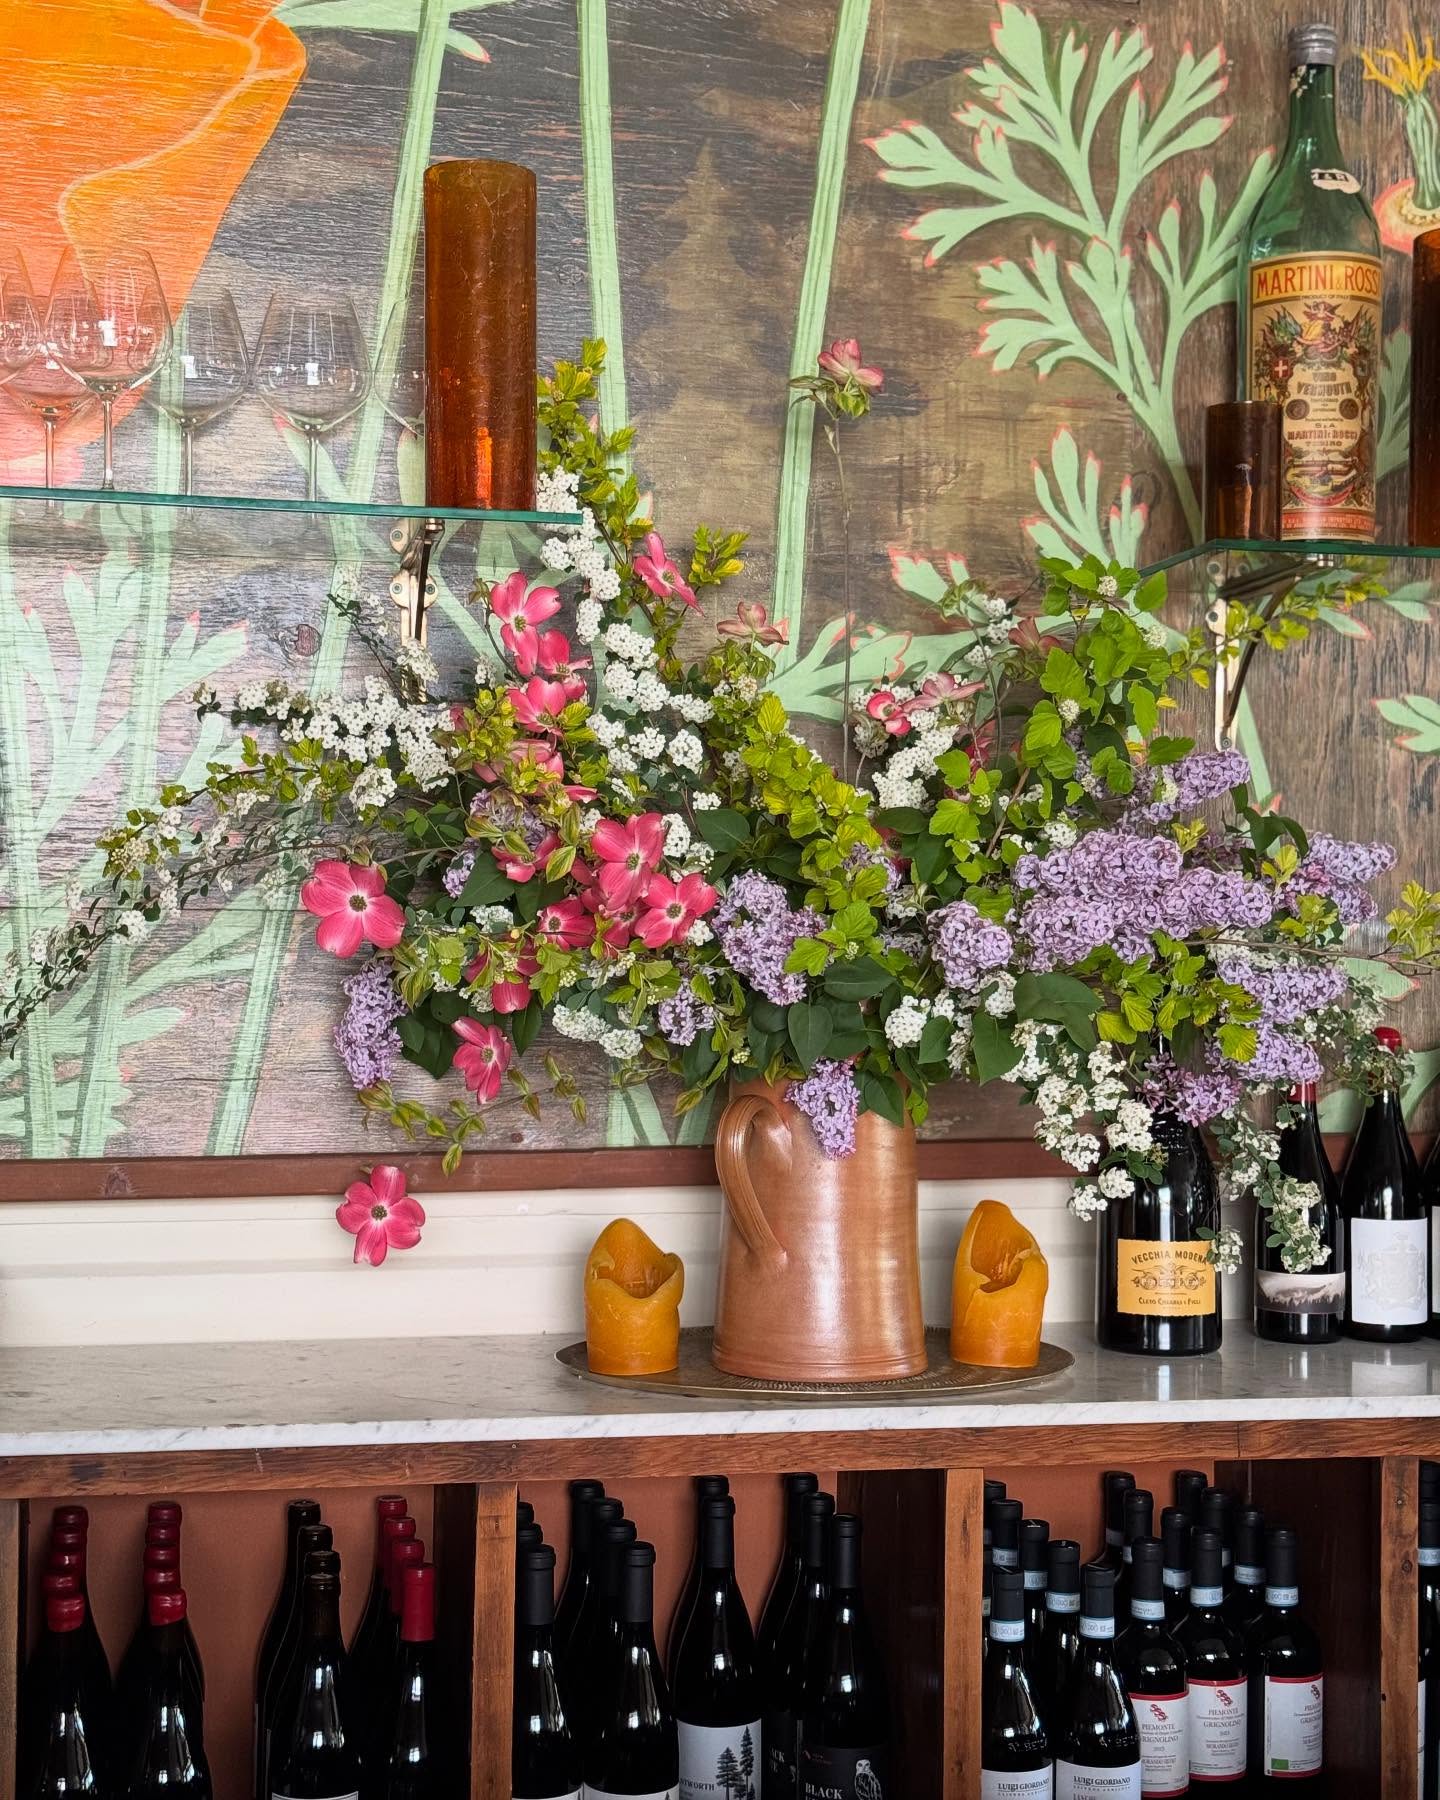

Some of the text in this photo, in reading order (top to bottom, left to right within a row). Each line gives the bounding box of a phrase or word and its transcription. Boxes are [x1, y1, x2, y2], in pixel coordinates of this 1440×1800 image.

[1256, 264, 1334, 298] MARTINI
[1297, 381, 1352, 396] VERMOUTH
[1131, 1250, 1207, 1265] VECCHIA MODENA
[998, 1783, 1018, 1792] LUIGI
[1073, 1775, 1094, 1786] LUIGI
[1095, 1776, 1130, 1786] GIORDANO
[805, 1782, 843, 1800] BLACK
